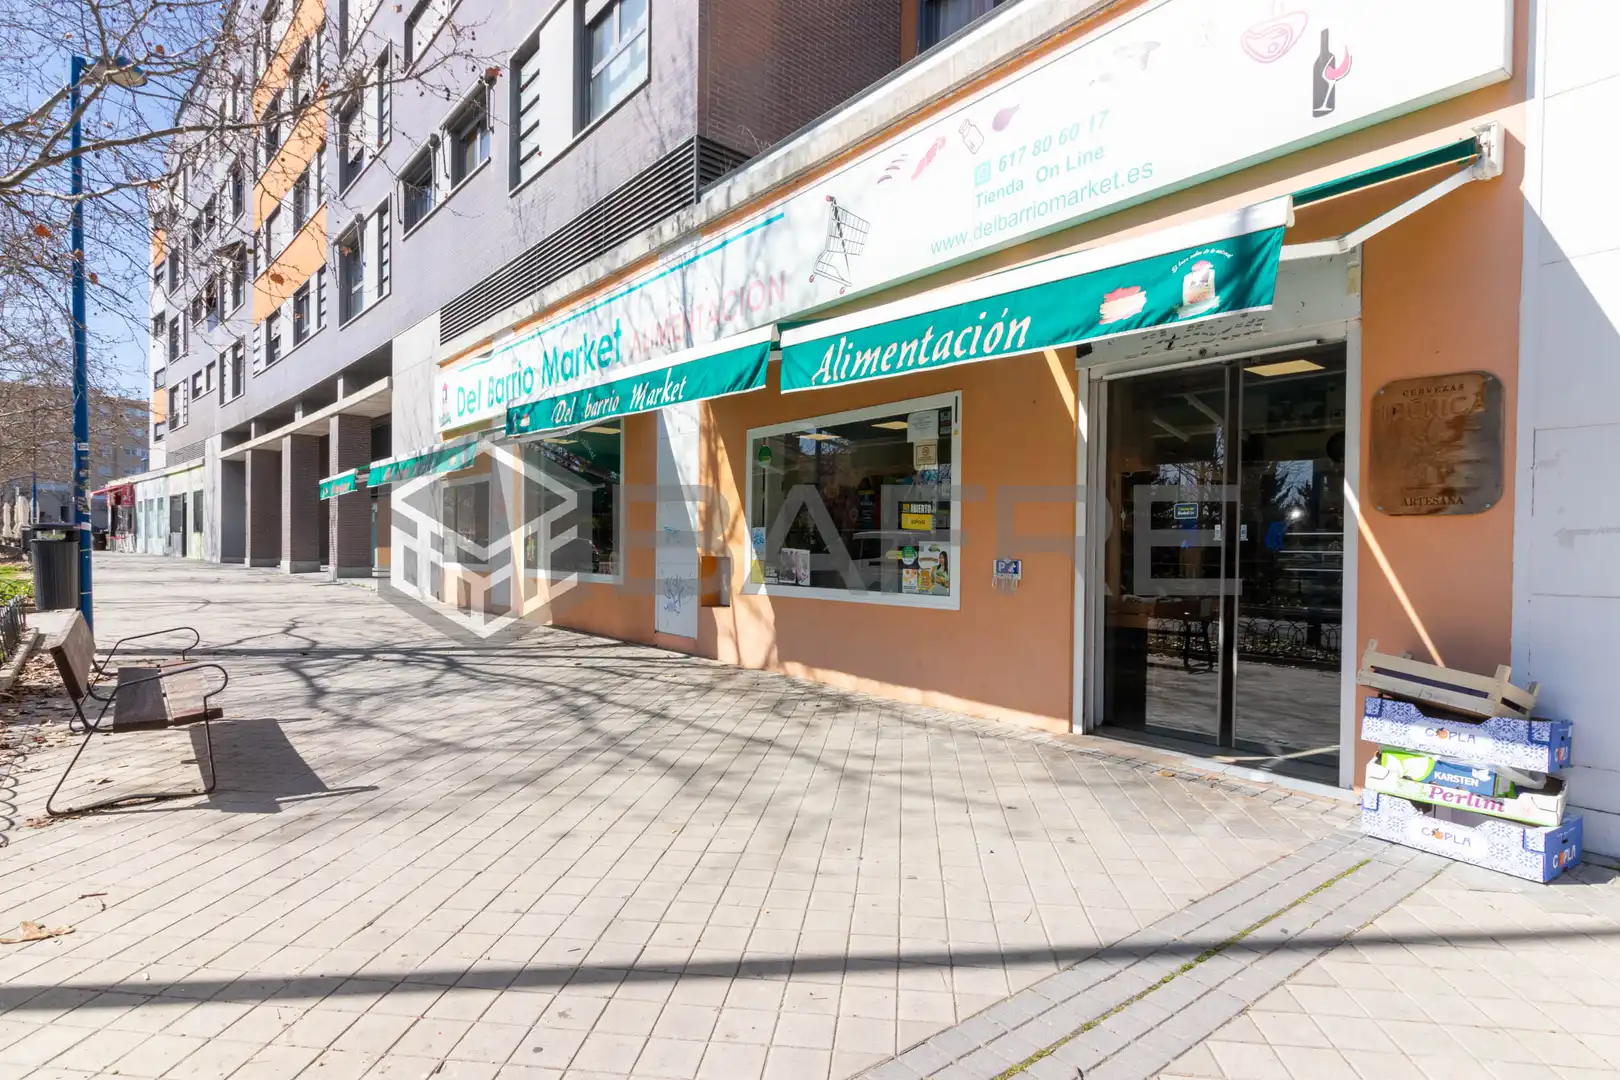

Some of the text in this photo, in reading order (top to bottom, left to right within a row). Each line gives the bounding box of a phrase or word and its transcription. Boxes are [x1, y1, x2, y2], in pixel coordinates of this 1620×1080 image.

[998, 109, 1110, 172] 617 80 60 17
[975, 143, 1106, 208] Tienda On Line
[930, 160, 1154, 253] www.delbarriomarket.es
[457, 379, 481, 417] Del
[488, 361, 534, 408] Barrio
[541, 319, 622, 386] Market
[812, 308, 1032, 385] Alimentación
[552, 368, 687, 424] Del barrio Market
[1402, 384, 1465, 397] CERVEZAS
[910, 503, 932, 514] ABIERTO
[1400, 496, 1464, 507] ARTESANA
[1428, 785, 1505, 812] Perlim
[1434, 771, 1479, 787] KARSTEN
